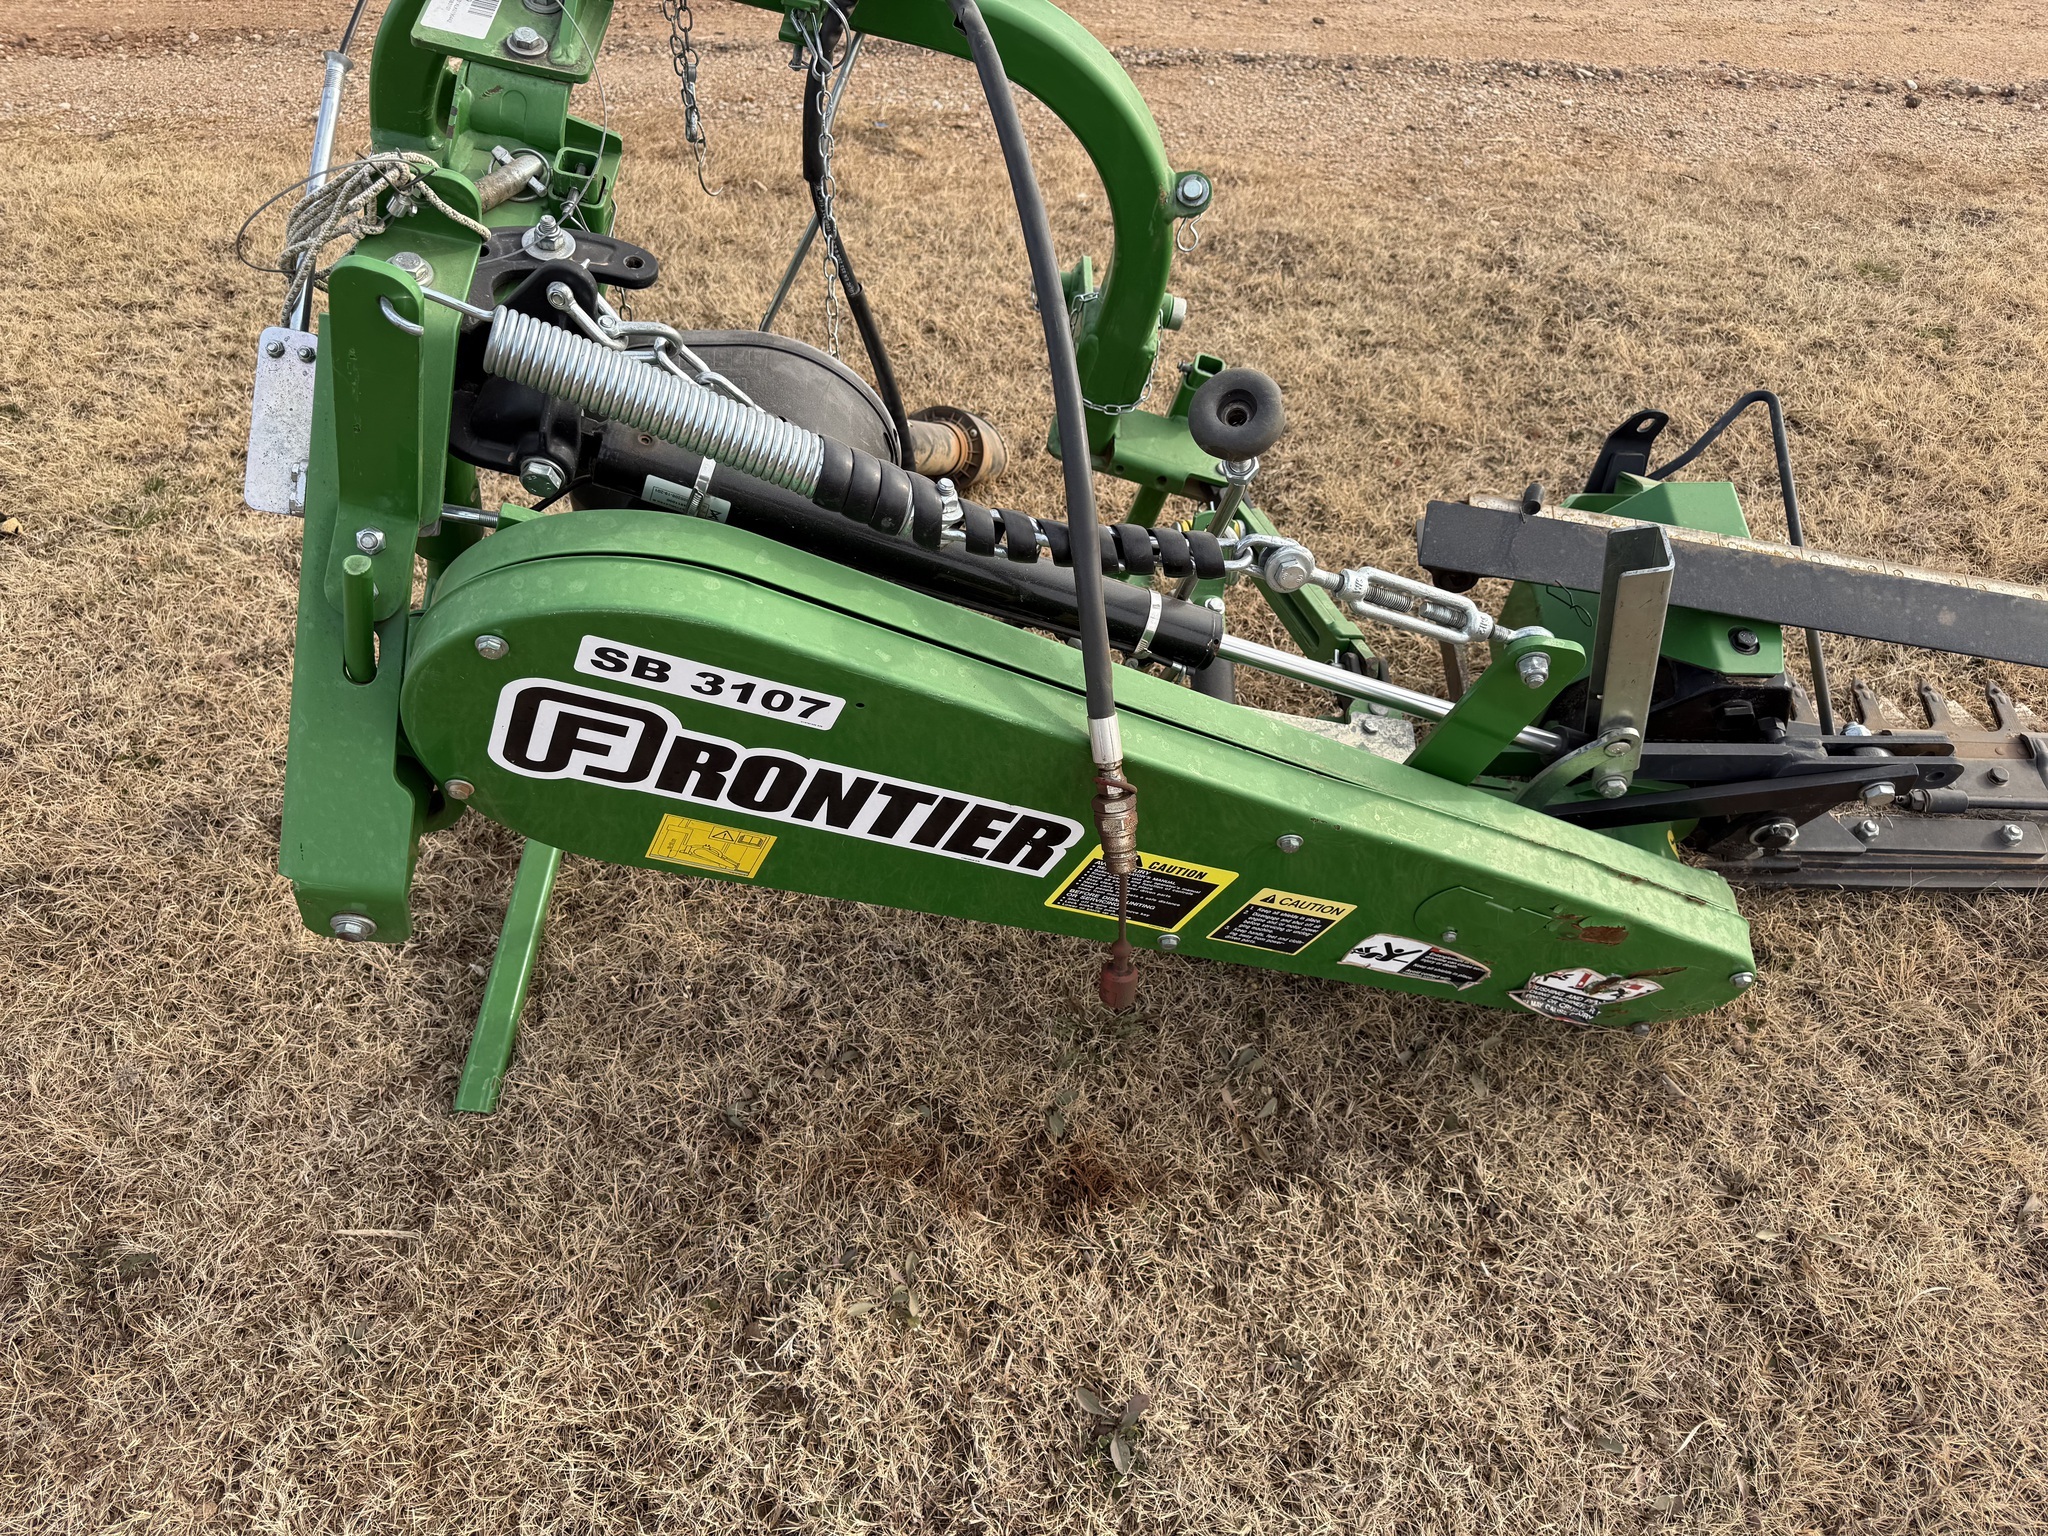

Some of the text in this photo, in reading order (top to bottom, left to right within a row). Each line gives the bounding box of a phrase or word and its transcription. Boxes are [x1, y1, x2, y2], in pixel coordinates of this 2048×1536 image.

[591, 647, 831, 719] SB 3107
[502, 686, 1073, 867] FRONTIER
[1148, 861, 1208, 880] CAUTION
[1069, 889, 1100, 898] BEFORE
[1080, 896, 1119, 906] SERVICING
[1279, 897, 1345, 916] CAUTION
